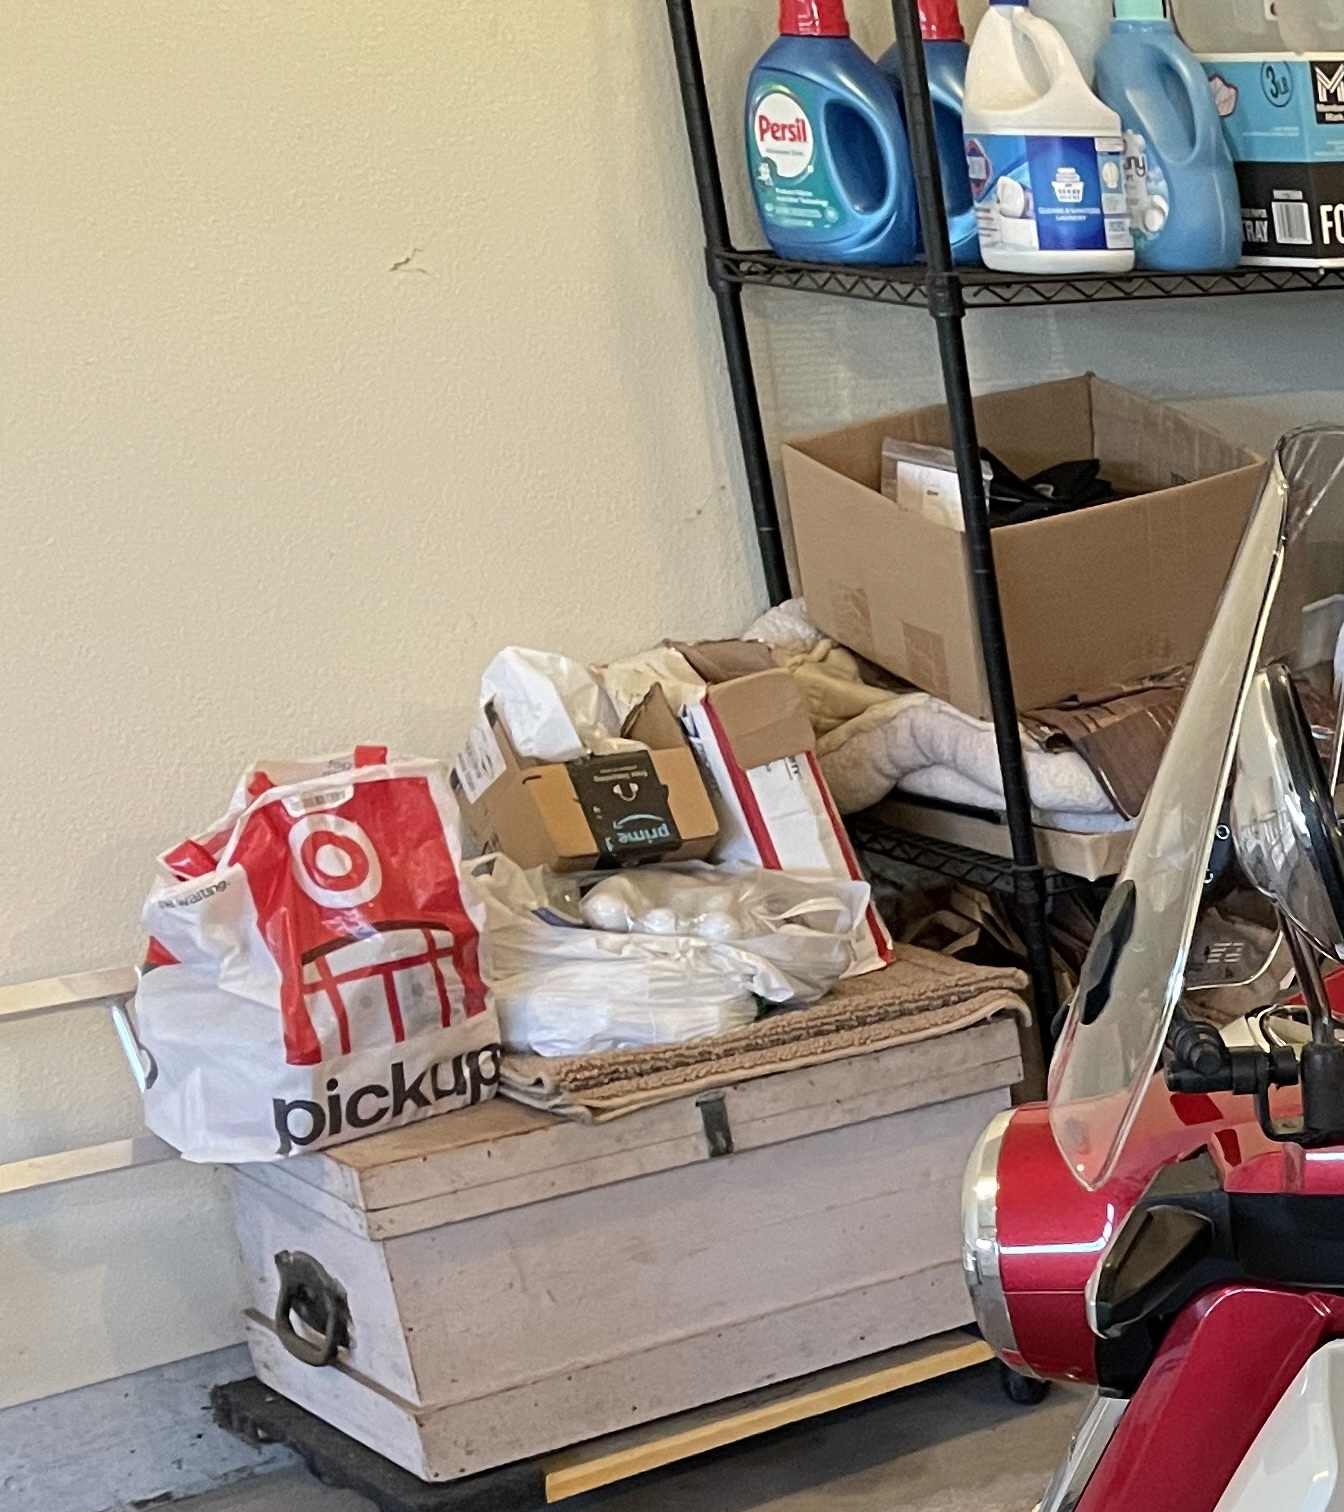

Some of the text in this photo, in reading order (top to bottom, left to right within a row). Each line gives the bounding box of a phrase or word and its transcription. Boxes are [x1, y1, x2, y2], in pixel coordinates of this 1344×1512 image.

[758, 114, 808, 143] Persil
[618, 821, 671, 845] prime
[272, 1041, 503, 1156] pickup
